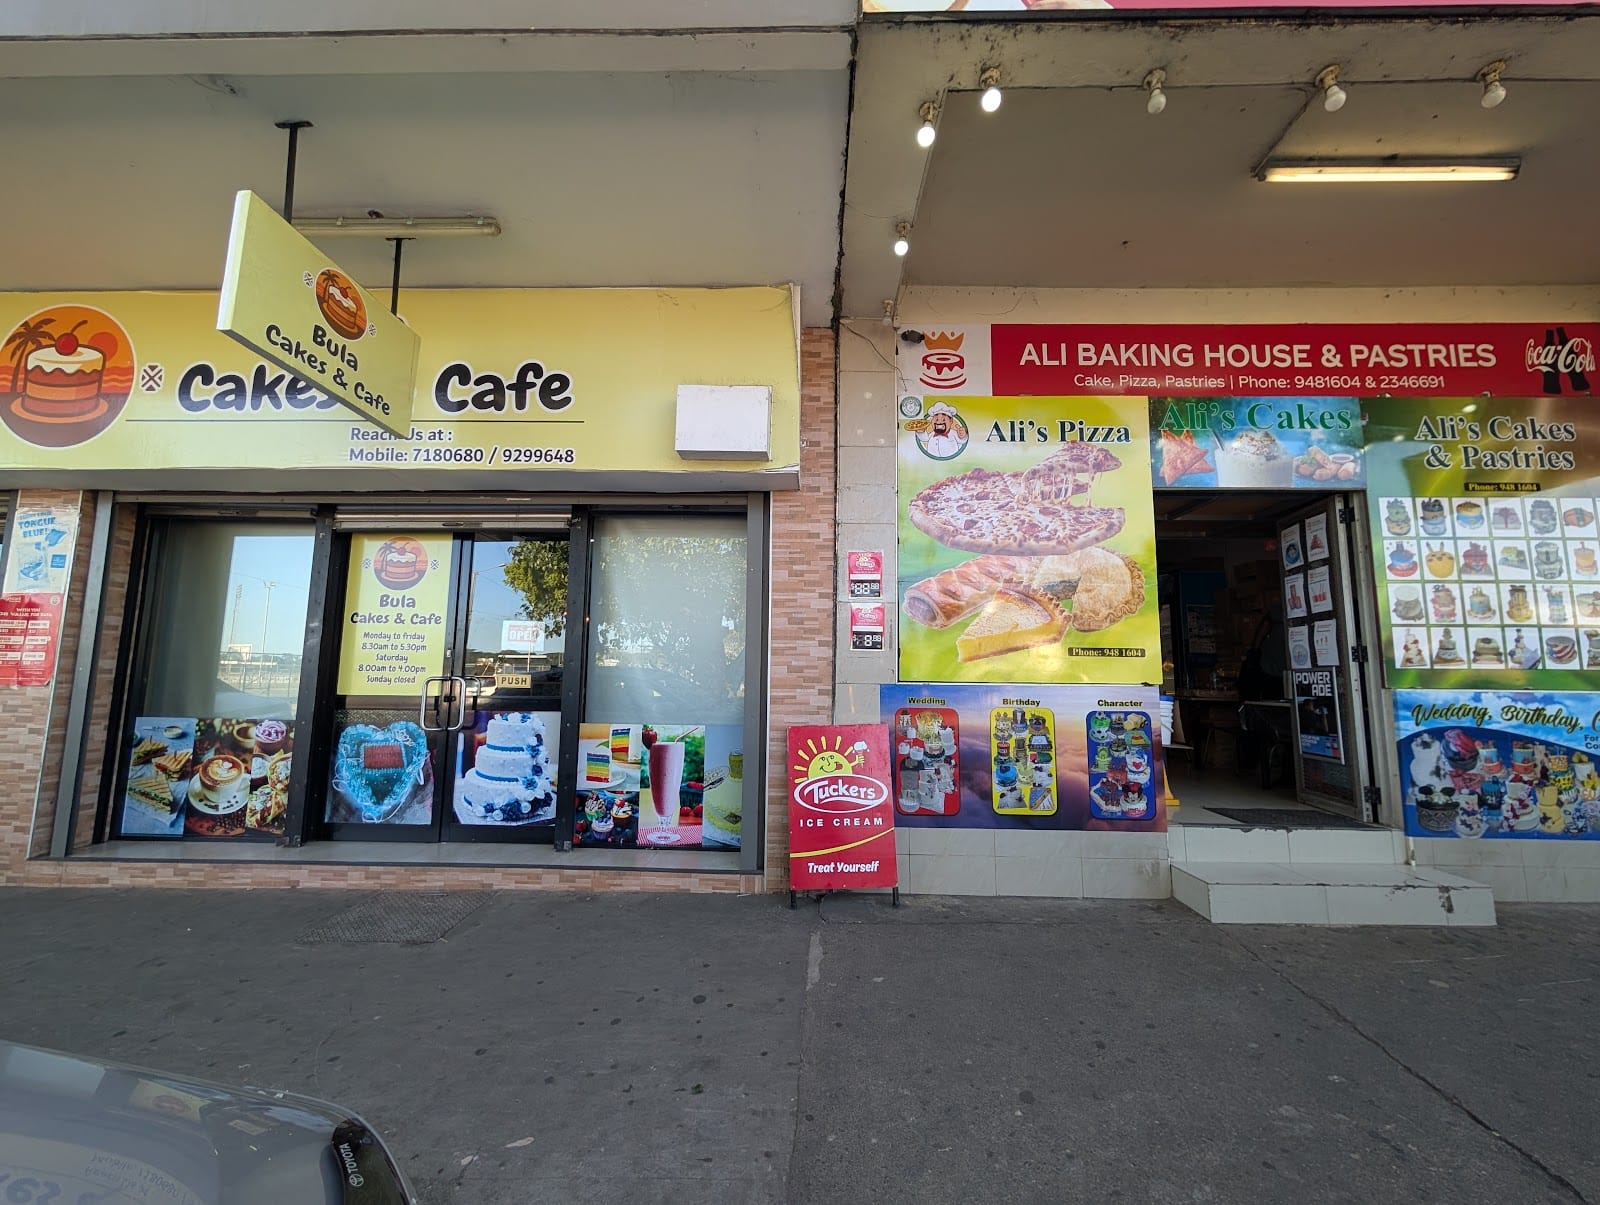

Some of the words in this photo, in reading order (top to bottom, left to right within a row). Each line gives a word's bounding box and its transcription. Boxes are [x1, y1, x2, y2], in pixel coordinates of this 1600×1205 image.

[313, 324, 358, 371] Bula
[1020, 343, 1066, 366] ALI
[1078, 344, 1193, 367] BAKING
[1204, 344, 1312, 367] HOUSE
[1320, 344, 1343, 367] &
[1350, 344, 1497, 368] PASTRIES
[1525, 338, 1596, 373] Coca-Cola
[265, 324, 328, 375] Cakes
[333, 367, 348, 391] &
[354, 382, 390, 416] Cafe
[435, 362, 572, 412] Cafe
[1074, 374, 1115, 388] Cake,
[1120, 375, 1161, 389] Pizza,
[1165, 375, 1225, 388] Pastries
[1239, 376, 1290, 388] Phone:
[1295, 376, 1361, 389] 9481604
[1365, 376, 1377, 388] &
[1380, 376, 1445, 389] 2346691
[1159, 402, 1235, 431] Ali's
[1247, 402, 1352, 431] Cakes
[985, 420, 1047, 443] Ali's
[1057, 420, 1131, 443] Pizza
[1415, 416, 1480, 441] Ali's
[1488, 416, 1576, 441] Cakes
[349, 447, 408, 462] Mobile:
[413, 448, 484, 463] 7180680
[503, 448, 575, 463] 9299648
[1425, 445, 1452, 469] &
[1460, 446, 1576, 471] Pastries
[1468, 483, 1498, 491] Phone:
[380, 594, 416, 608] Bula
[351, 612, 390, 624] Cakes
[394, 613, 405, 624] &
[411, 613, 442, 625] Cafe
[363, 631, 391, 643] Monday
[393, 631, 401, 640] to
[361, 642, 389, 651] 8.30am
[390, 643, 398, 651] to
[400, 643, 427, 653] 5.30pm
[1072, 648, 1102, 657] Phone:
[1104, 649, 1120, 657] 948
[1122, 649, 1142, 658] 1604
[375, 653, 408, 664] Saturday
[358, 664, 387, 673] 8.00am
[388, 664, 396, 672] to
[398, 665, 427, 675] 4.00pm
[366, 674, 392, 685] Sunday
[393, 675, 416, 684] closed
[501, 677, 528, 686] PUSH
[1295, 671, 1332, 685] POWER
[1311, 685, 1333, 697] ADE
[908, 697, 946, 706] Wedding
[1002, 698, 1041, 708] Birthday
[1097, 699, 1143, 708] Character
[1411, 703, 1492, 727] Wedding,
[1583, 734, 1599, 742] For
[804, 778, 876, 804] Tuckers
[800, 818, 824, 827] ICE
[833, 818, 883, 827] CREAM
[808, 862, 835, 873] Treat
[837, 861, 879, 873] Yourself
[339, 1142, 358, 1174] TOYOTA
